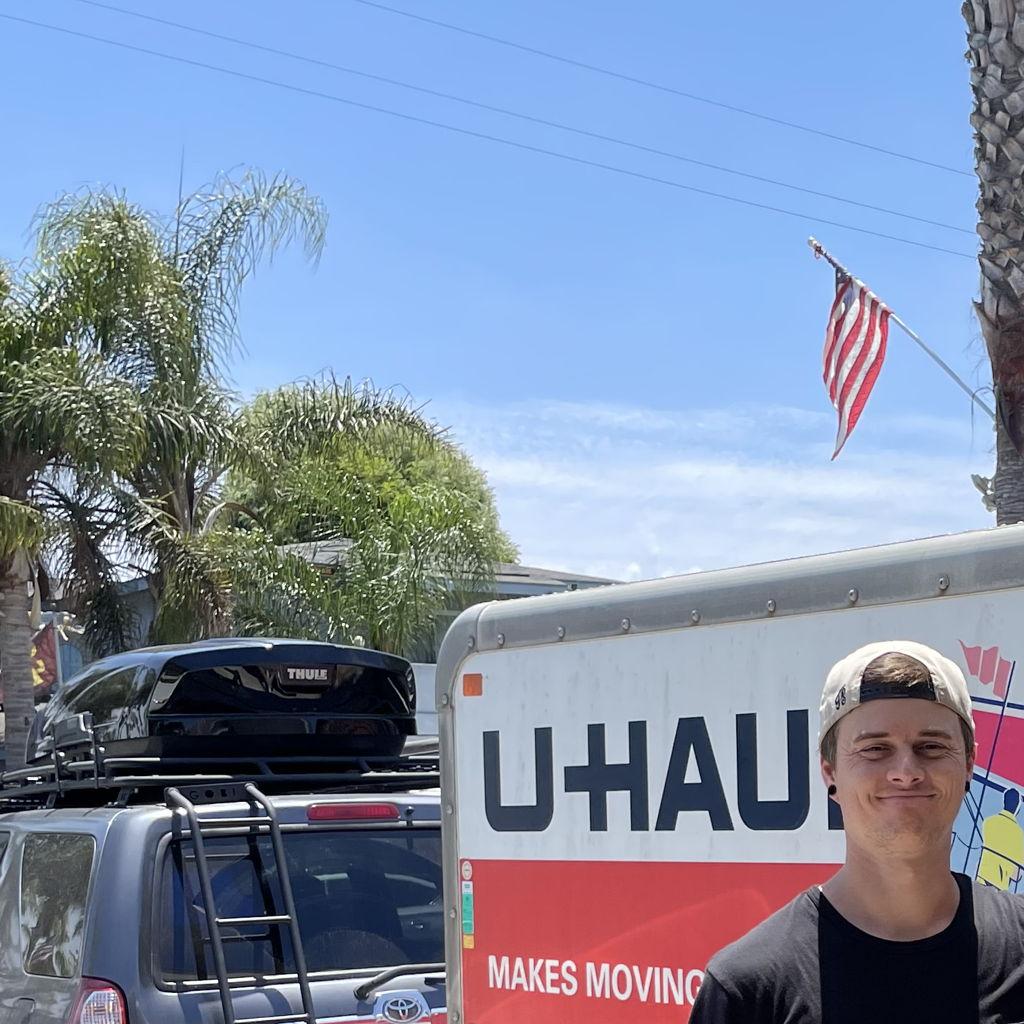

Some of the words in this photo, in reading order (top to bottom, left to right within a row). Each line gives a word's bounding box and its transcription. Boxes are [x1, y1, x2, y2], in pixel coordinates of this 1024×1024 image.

[287, 668, 328, 680] THULE
[488, 954, 578, 996] MAKES
[586, 962, 706, 1006] MOVING
